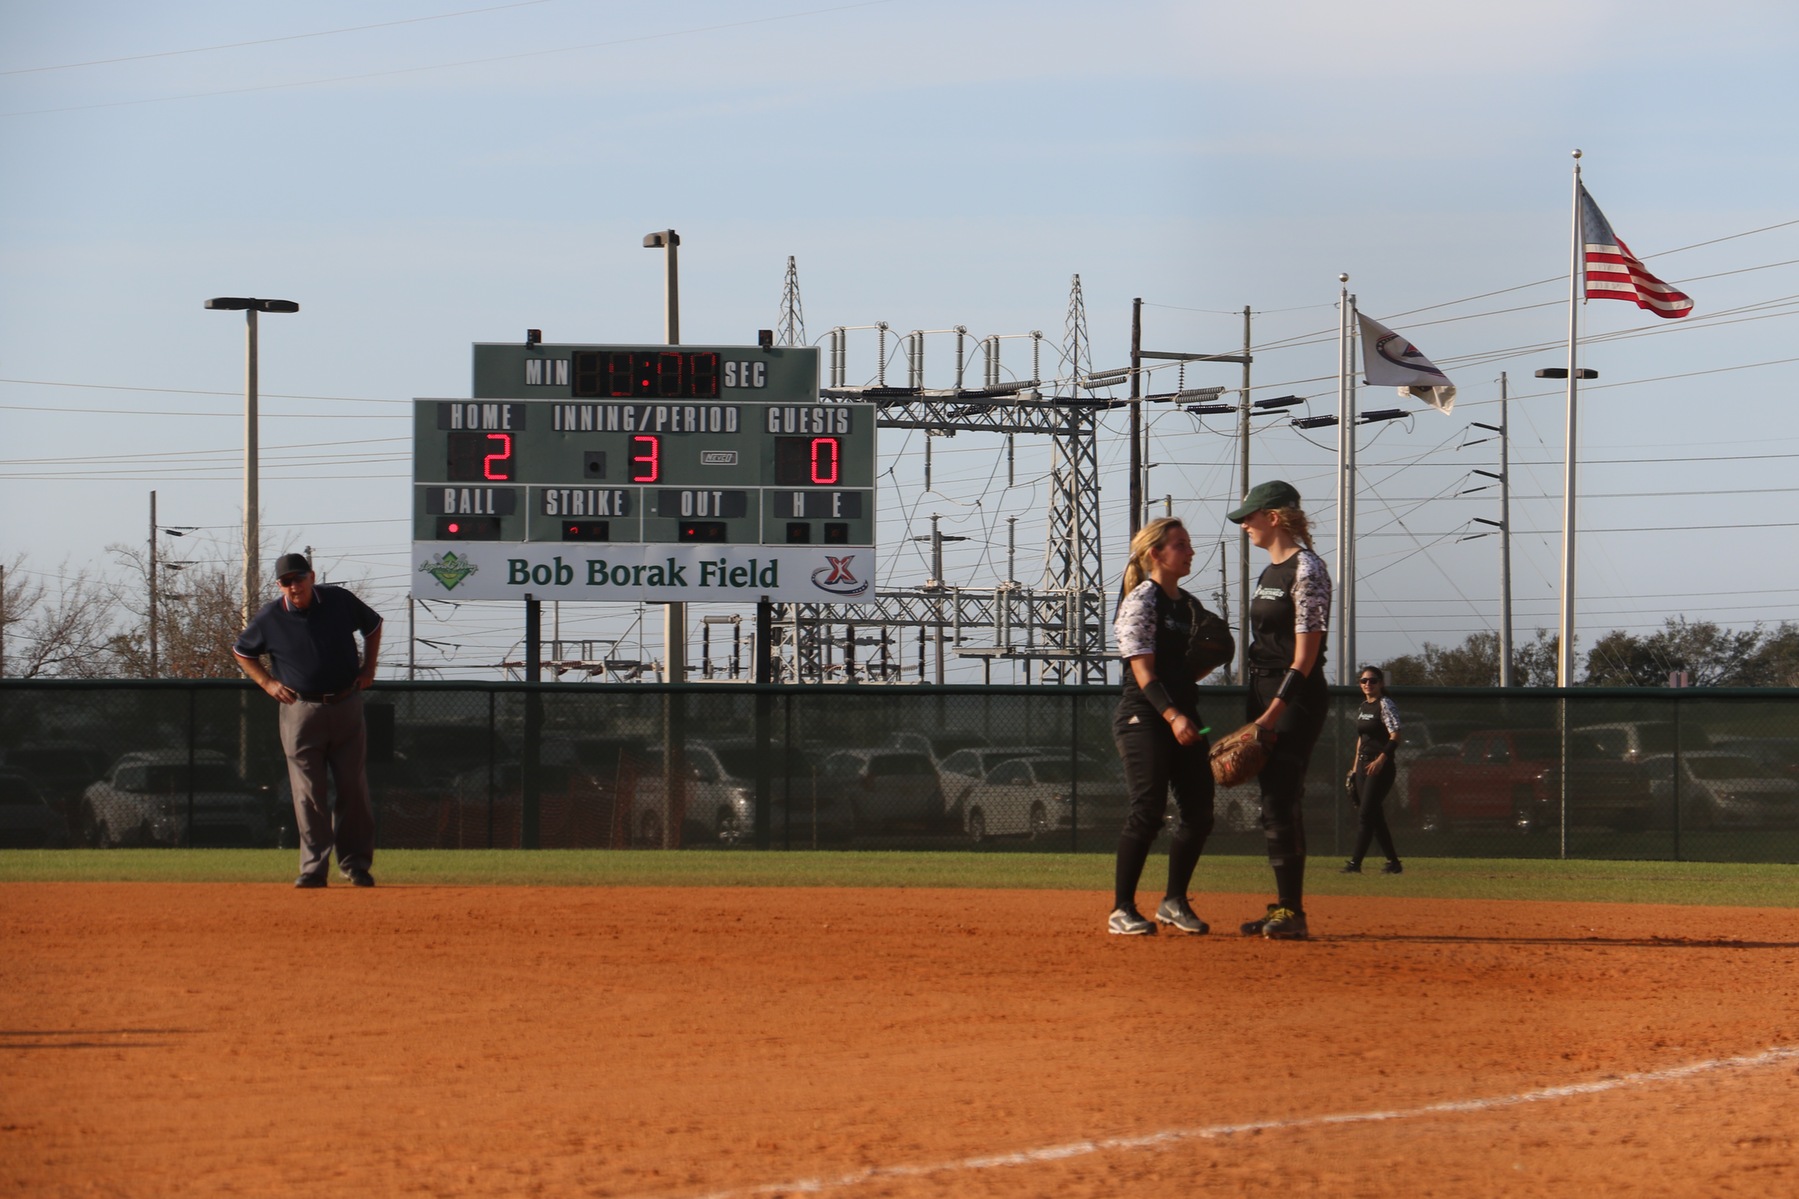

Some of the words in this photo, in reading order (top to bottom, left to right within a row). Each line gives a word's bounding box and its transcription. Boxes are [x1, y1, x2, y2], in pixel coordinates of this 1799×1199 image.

[525, 359, 568, 385] MIN
[724, 361, 765, 388] SEC
[451, 403, 512, 430] HOME
[554, 405, 738, 432] INNING/PERIOD
[768, 407, 848, 434] GUESTS
[484, 433, 511, 480] 2
[633, 435, 659, 482] 3
[811, 437, 838, 484] 0
[444, 488, 496, 514] BALL
[546, 489, 623, 516] STRIKE
[681, 490, 723, 517] OUT
[793, 491, 805, 518] H
[833, 492, 842, 518] E
[507, 556, 574, 585] Bob
[586, 557, 688, 587] Borak
[698, 557, 780, 588] Field
